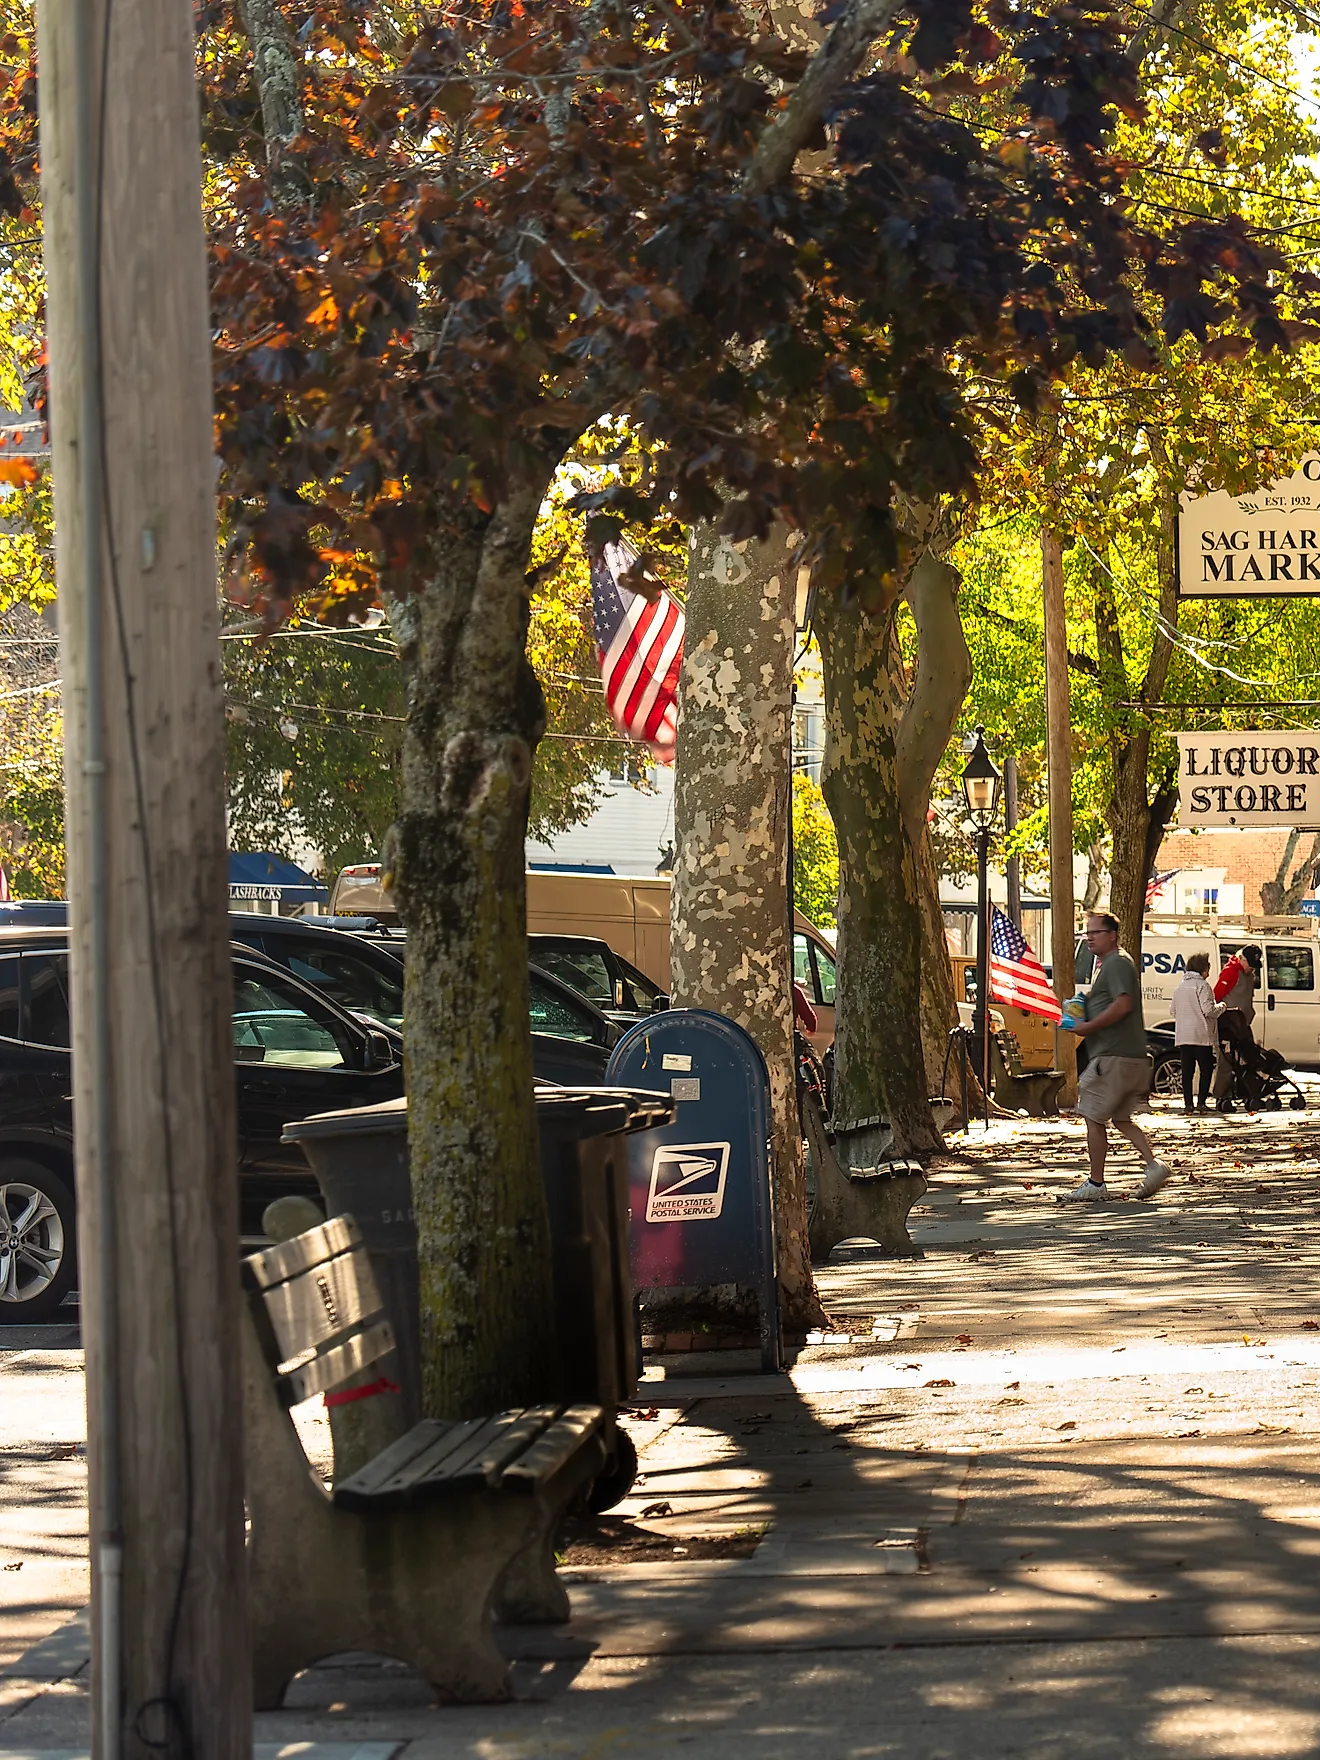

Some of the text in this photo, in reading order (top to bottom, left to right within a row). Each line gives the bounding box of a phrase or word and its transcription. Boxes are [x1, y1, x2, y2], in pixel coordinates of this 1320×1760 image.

[1264, 496, 1311, 506] EST. 1932
[1201, 530, 1250, 551] SAG
[1185, 746, 1320, 777] LIQUOR
[1190, 783, 1307, 813] STORE
[229, 886, 282, 900] LASHBACKS
[1302, 904, 1317, 913] AGE
[1142, 993, 1163, 1001] TEMS
[652, 1197, 714, 1209] UNITED STATES
[650, 1206, 716, 1217] POSTAL SERVICE
